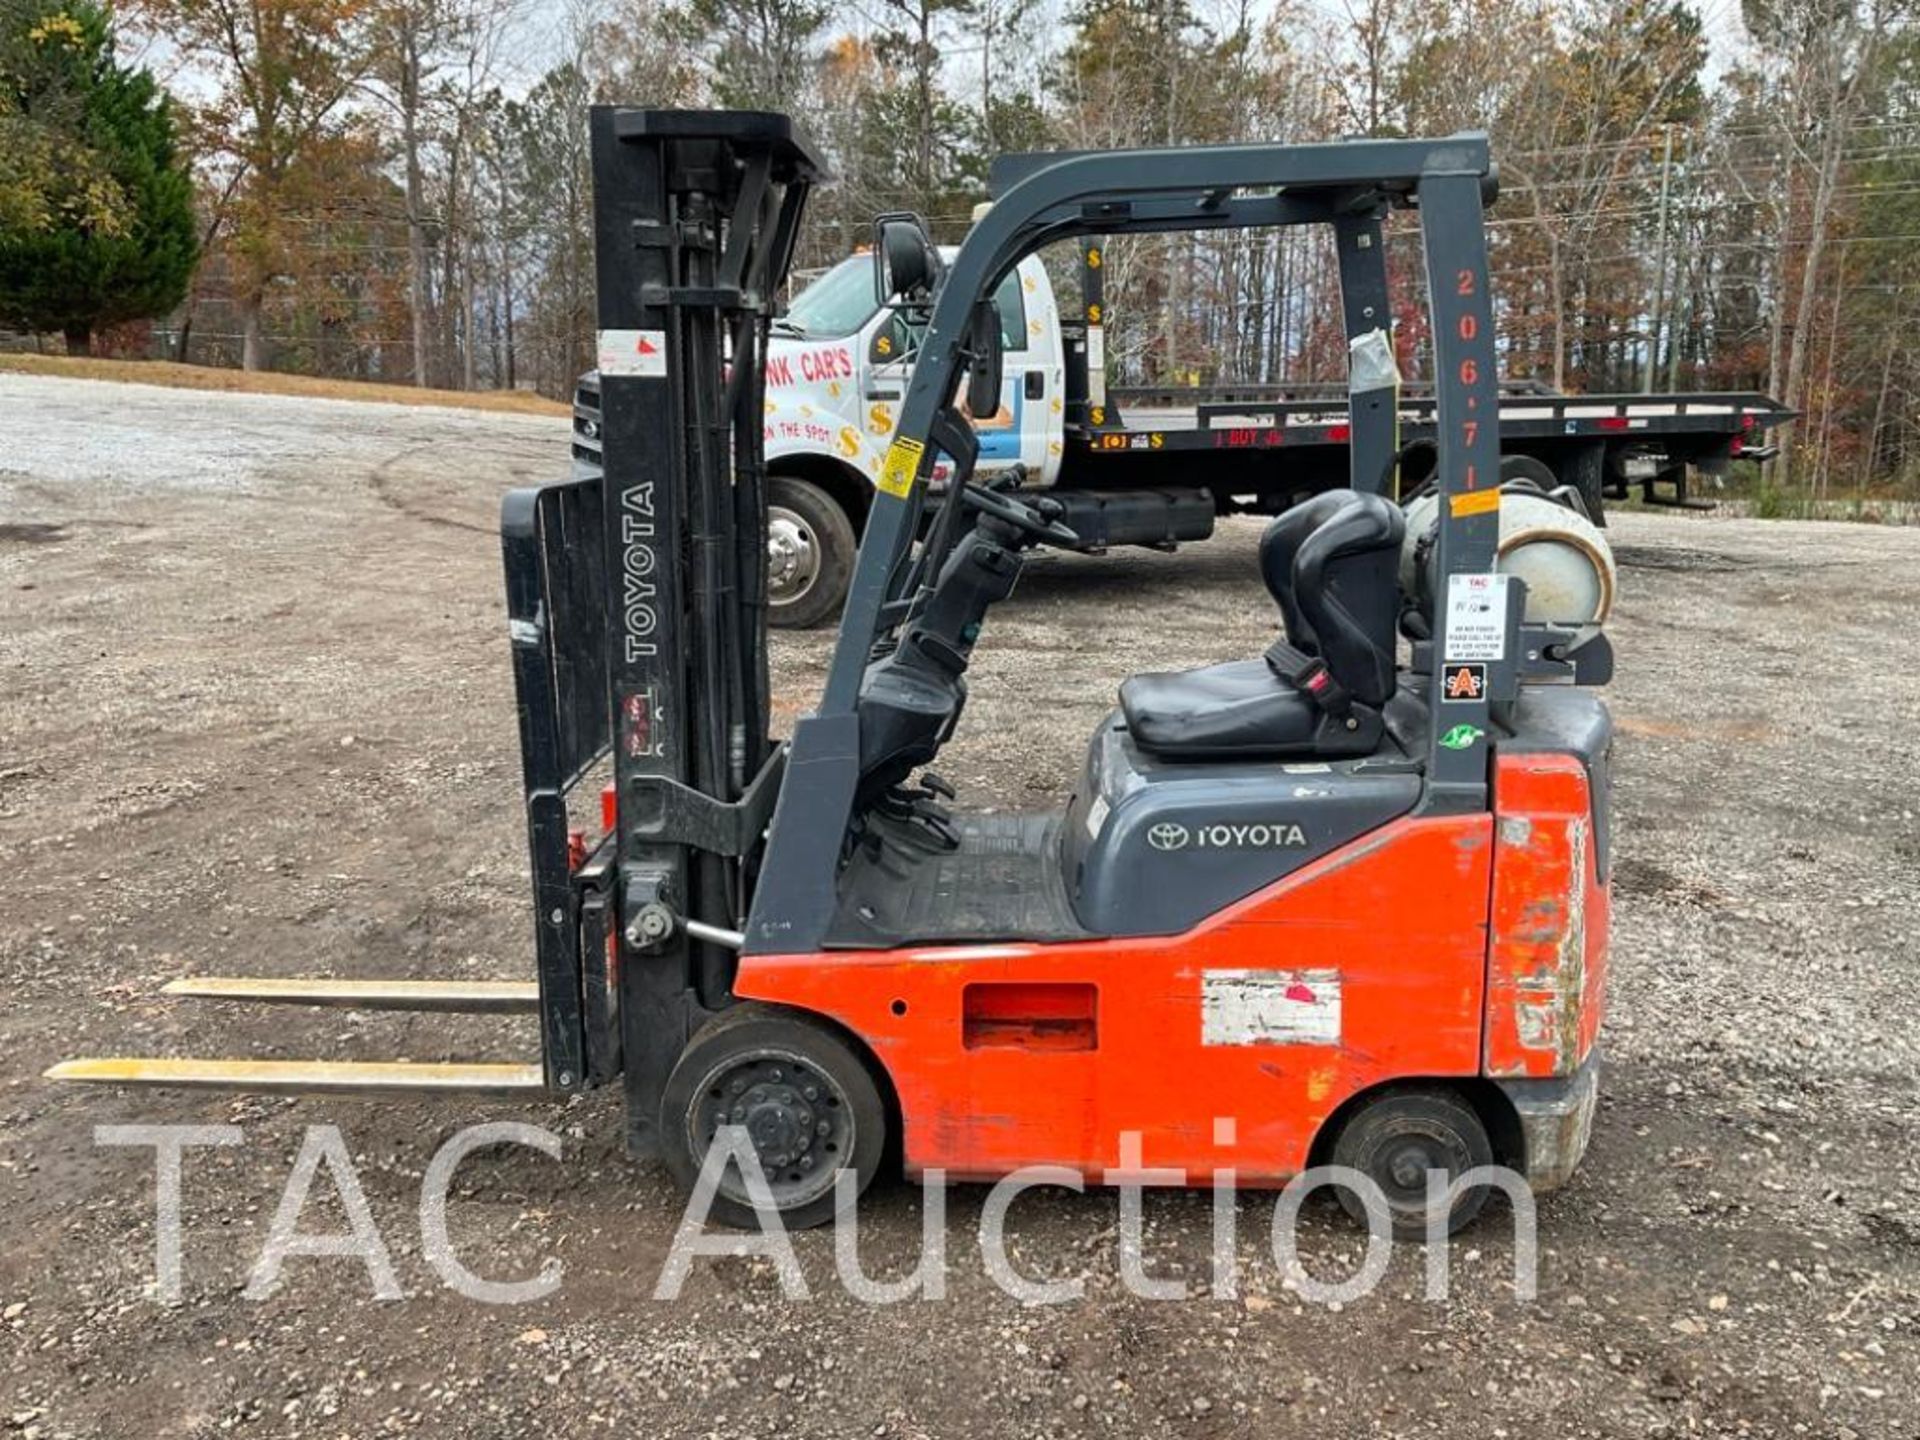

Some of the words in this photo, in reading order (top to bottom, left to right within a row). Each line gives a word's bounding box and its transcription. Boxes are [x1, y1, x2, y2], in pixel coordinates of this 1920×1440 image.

[764, 355, 794, 387] NK
[800, 347, 852, 383] CAR'S
[779, 421, 801, 438] THE
[804, 424, 830, 442] SPOT
[1228, 427, 1258, 447] BUY
[621, 480, 657, 664] TOYOTA
